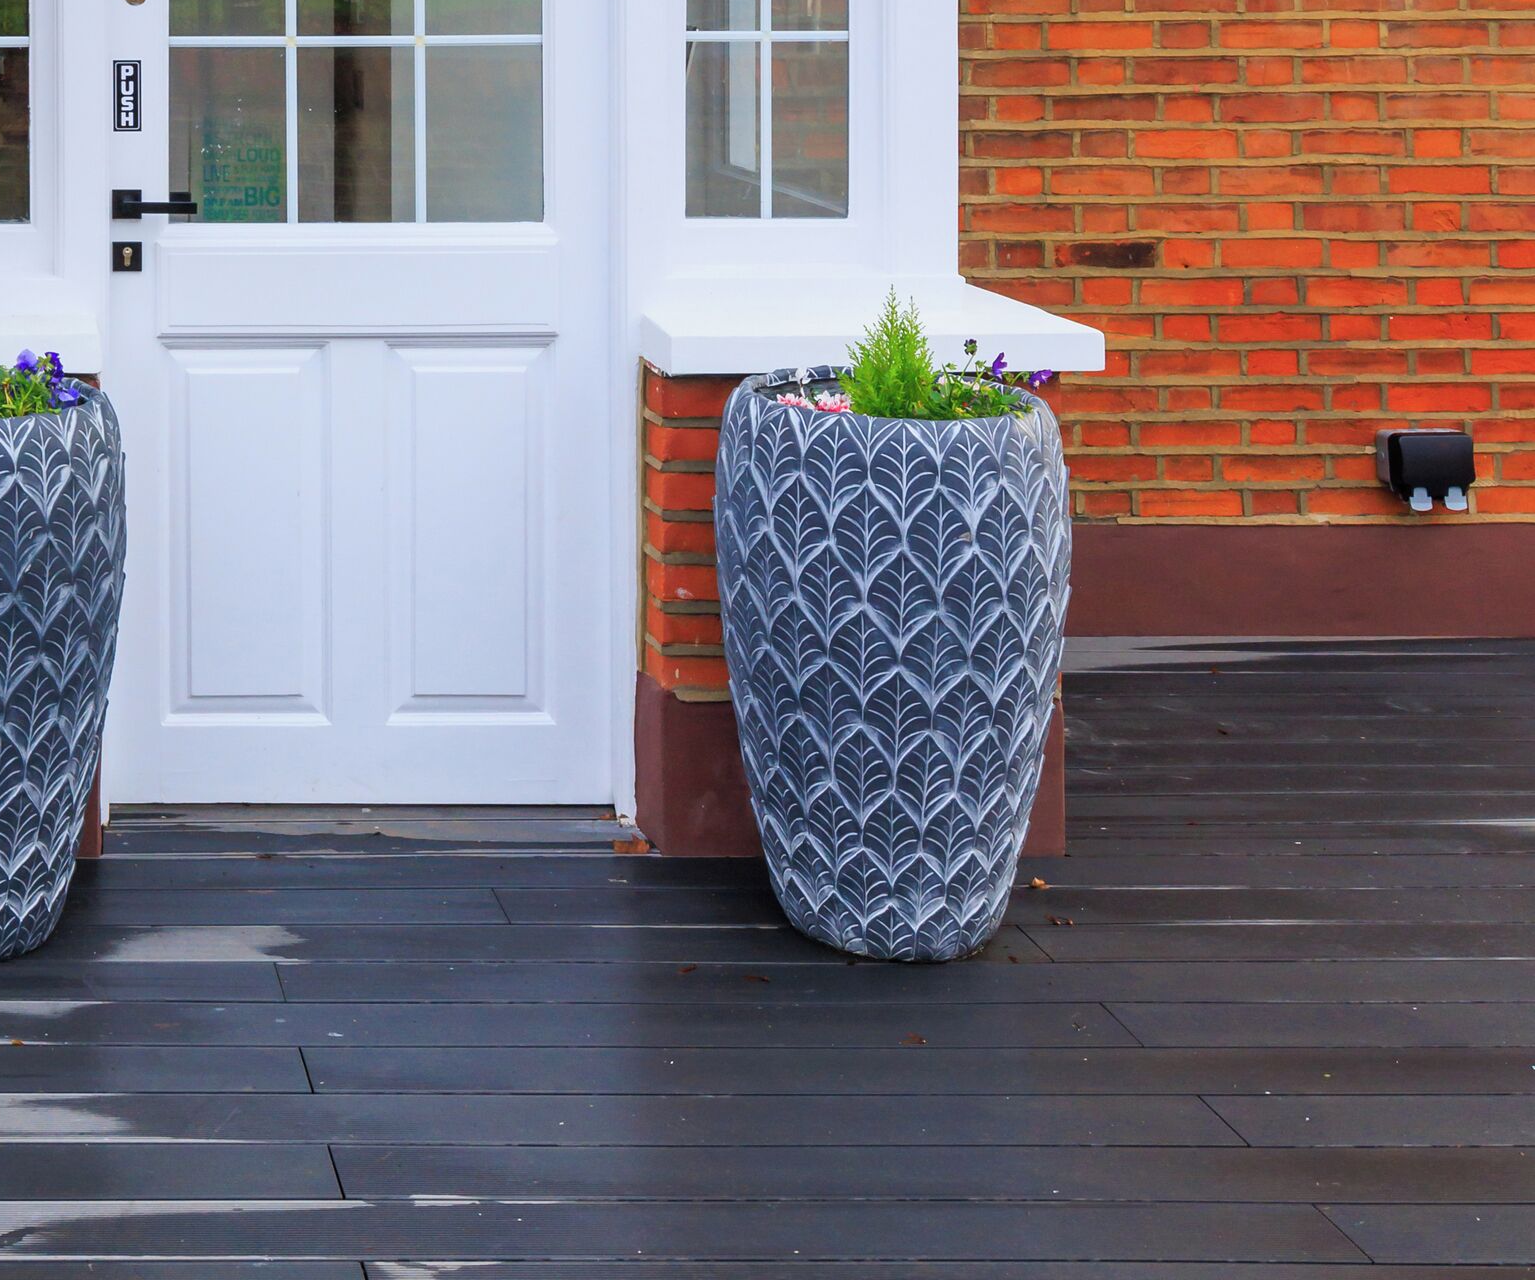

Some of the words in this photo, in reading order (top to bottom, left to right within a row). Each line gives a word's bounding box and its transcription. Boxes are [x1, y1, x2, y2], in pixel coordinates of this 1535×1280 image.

[121, 65, 134, 127] PUSH
[237, 147, 280, 162] LOUD
[244, 186, 280, 207] BIG
